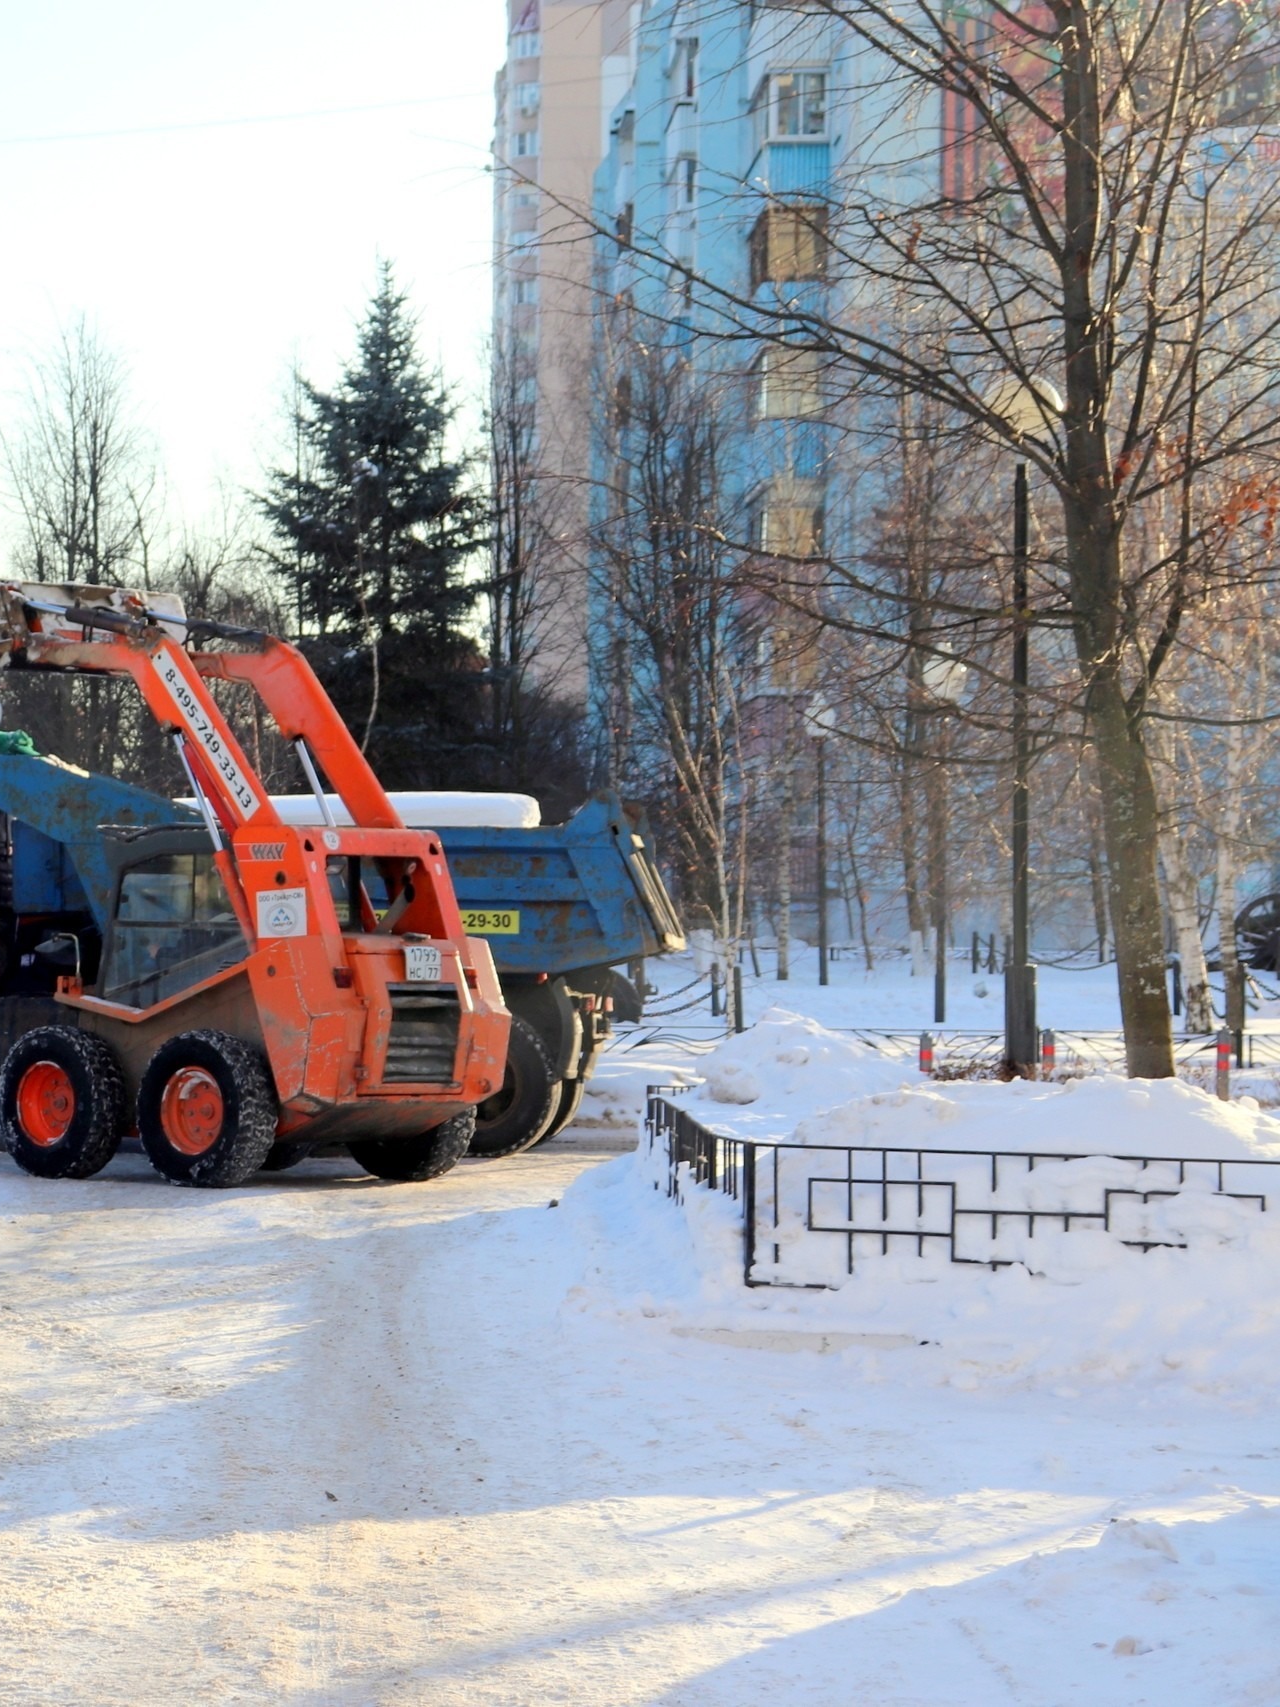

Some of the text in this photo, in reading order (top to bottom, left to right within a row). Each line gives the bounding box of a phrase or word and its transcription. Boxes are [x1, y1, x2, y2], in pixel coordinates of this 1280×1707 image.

[165, 668, 252, 809] 8-495-749-33-13
[251, 843, 286, 860] WAY
[410, 948, 437, 962] 1799
[427, 967, 438, 979] 77
